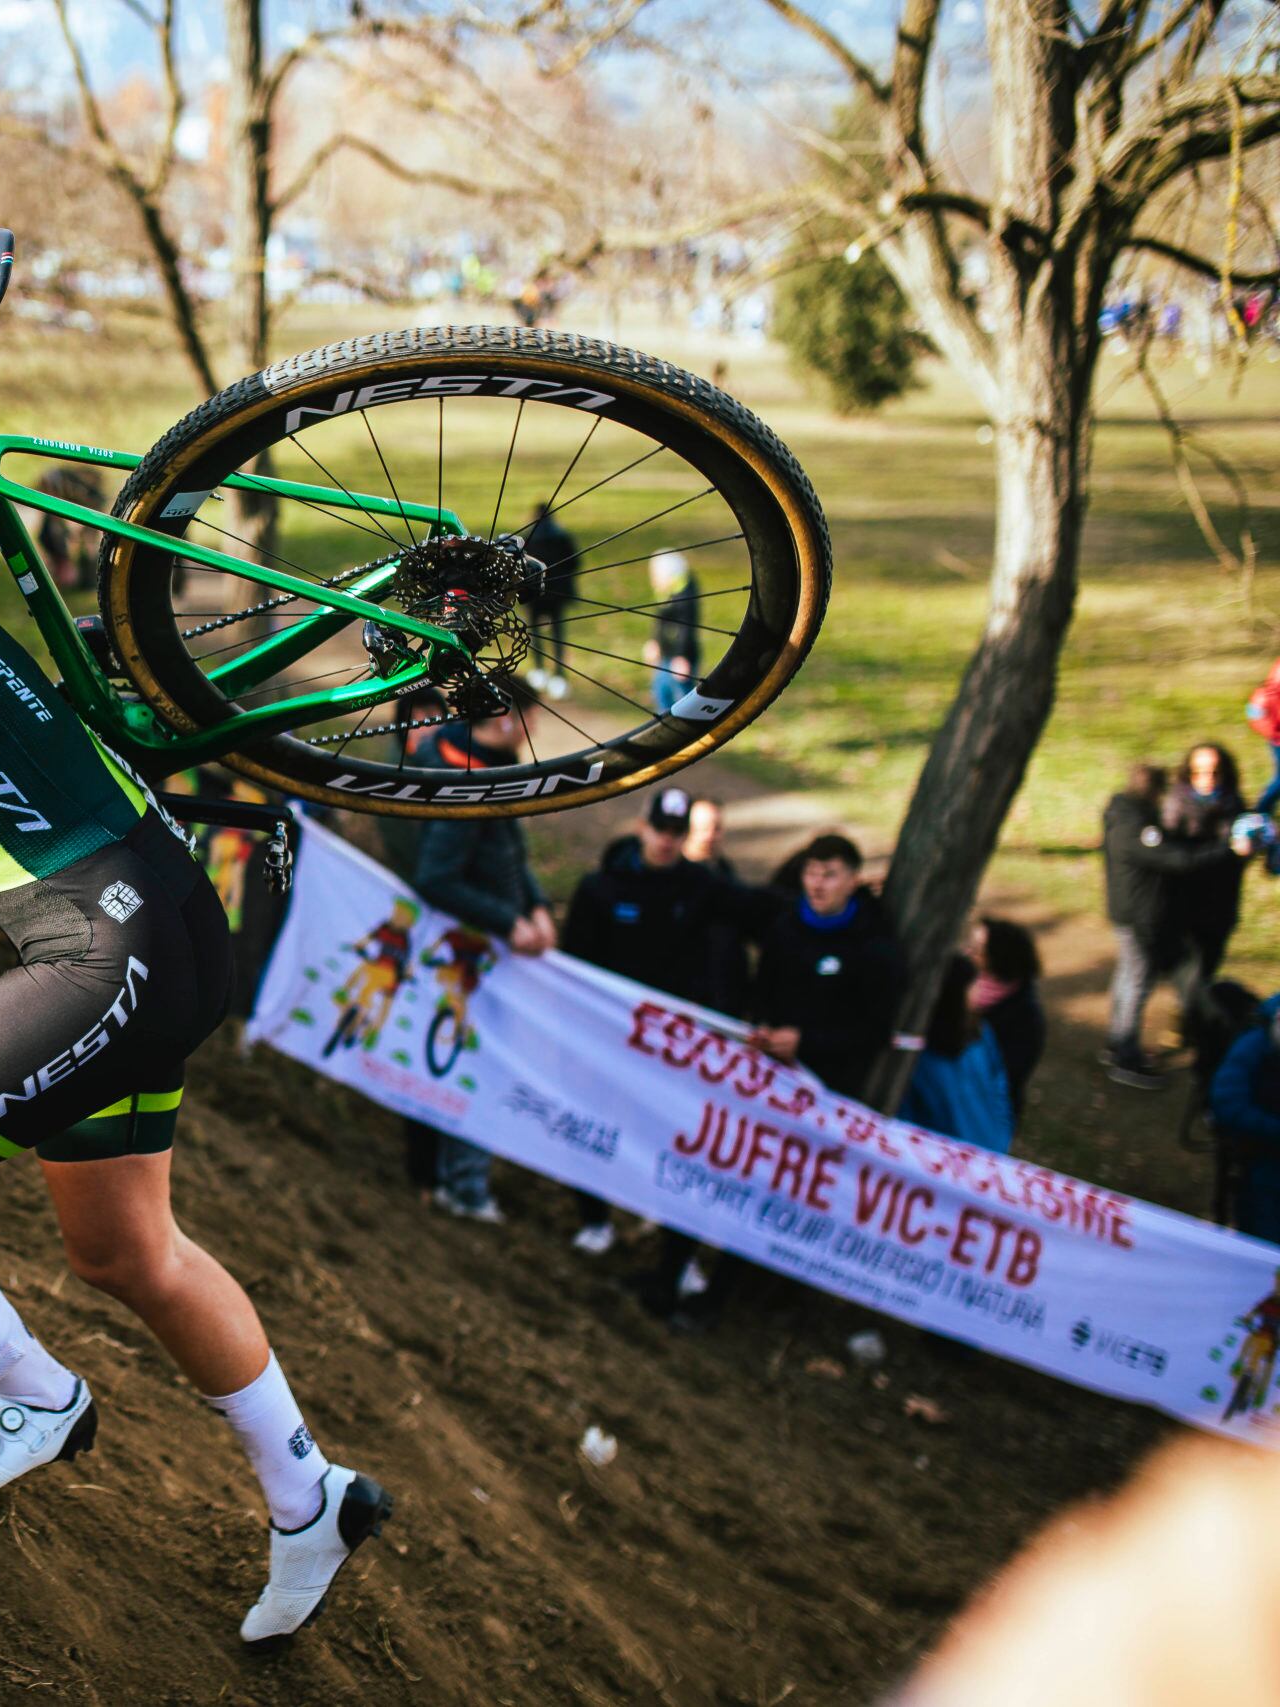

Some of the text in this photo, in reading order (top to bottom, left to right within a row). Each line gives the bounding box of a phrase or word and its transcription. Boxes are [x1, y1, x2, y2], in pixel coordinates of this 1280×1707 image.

[285, 375, 616, 435] NESTA
[32, 437, 114, 459] SOFIA RODRIGUEZ
[326, 760, 605, 803] NESTA
[673, 1101, 848, 1211] JUFRÉ
[854, 1162, 1044, 1288] VIC-ETB
